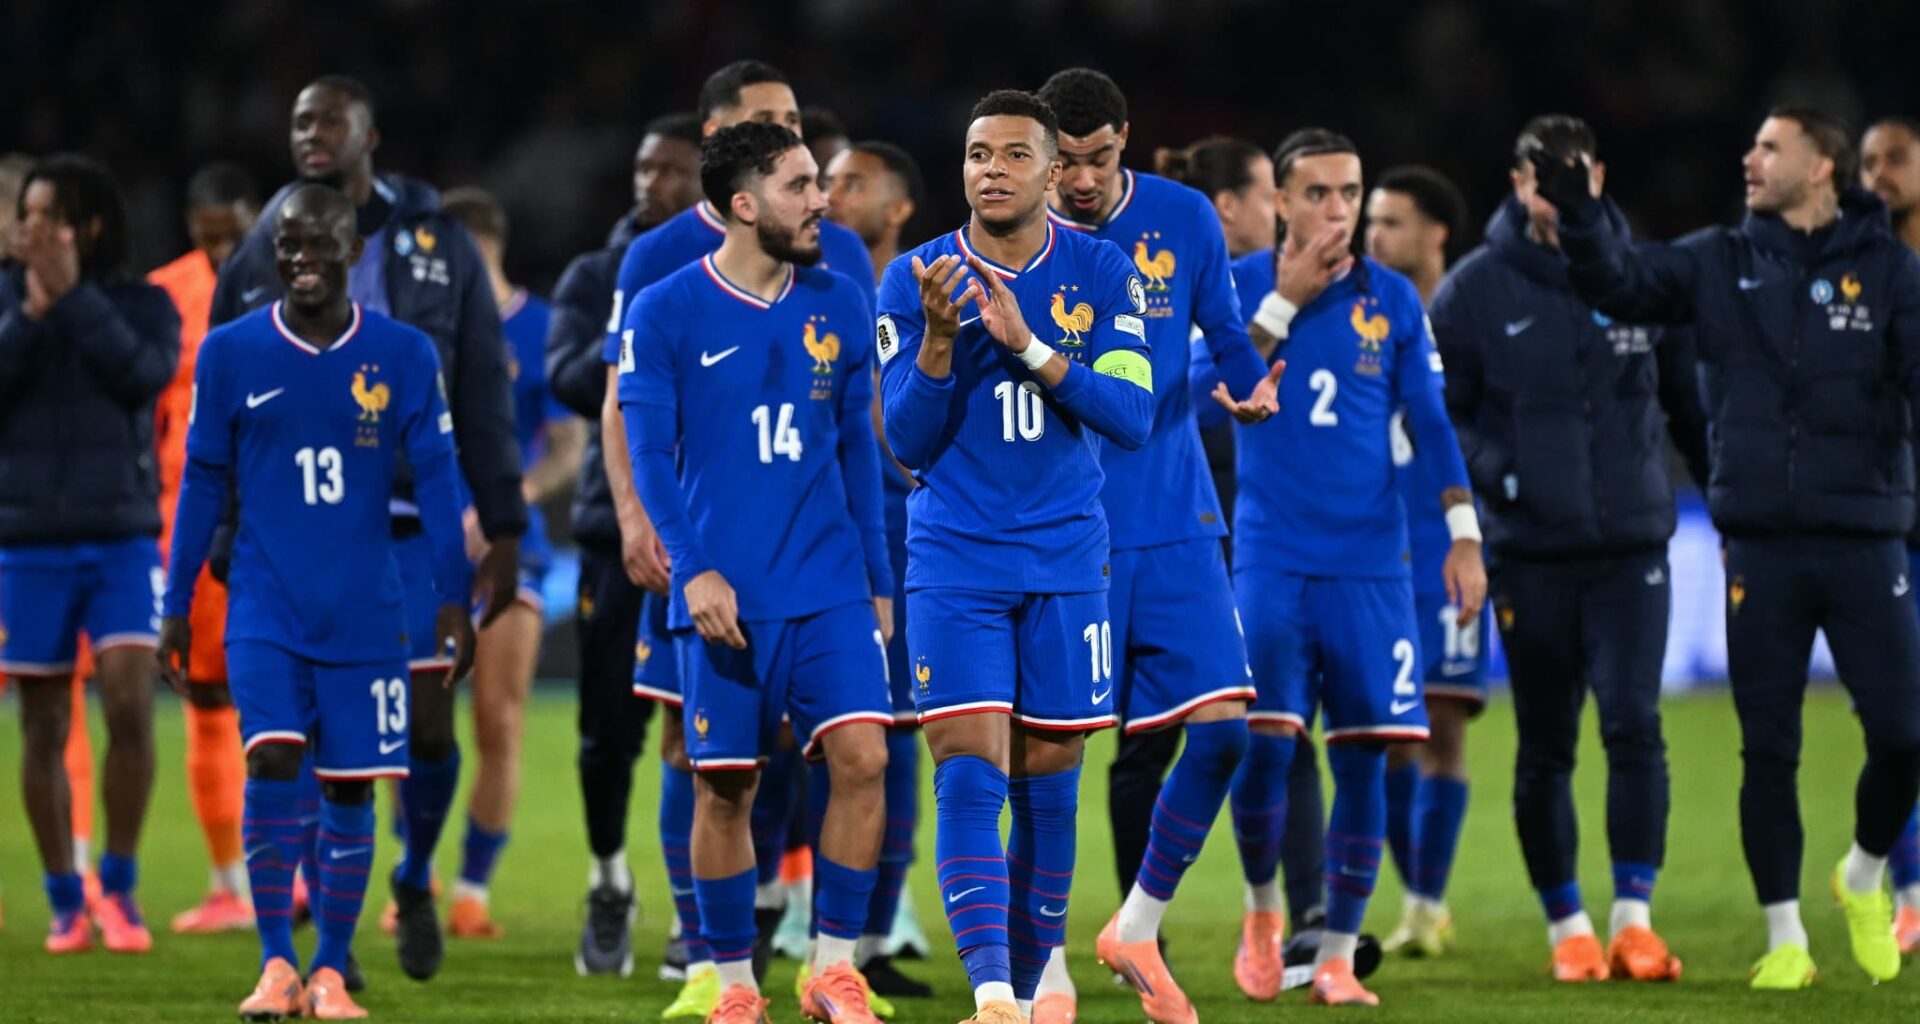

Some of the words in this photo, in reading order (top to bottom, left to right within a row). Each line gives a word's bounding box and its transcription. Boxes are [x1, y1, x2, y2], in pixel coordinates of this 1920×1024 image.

[994, 380, 1045, 442] 10
[1309, 368, 1338, 426] 2
[751, 402, 803, 464] 14
[294, 446, 344, 505] 13
[1083, 619, 1112, 684] 10
[1392, 638, 1416, 696] 2
[370, 678, 407, 735] 13
